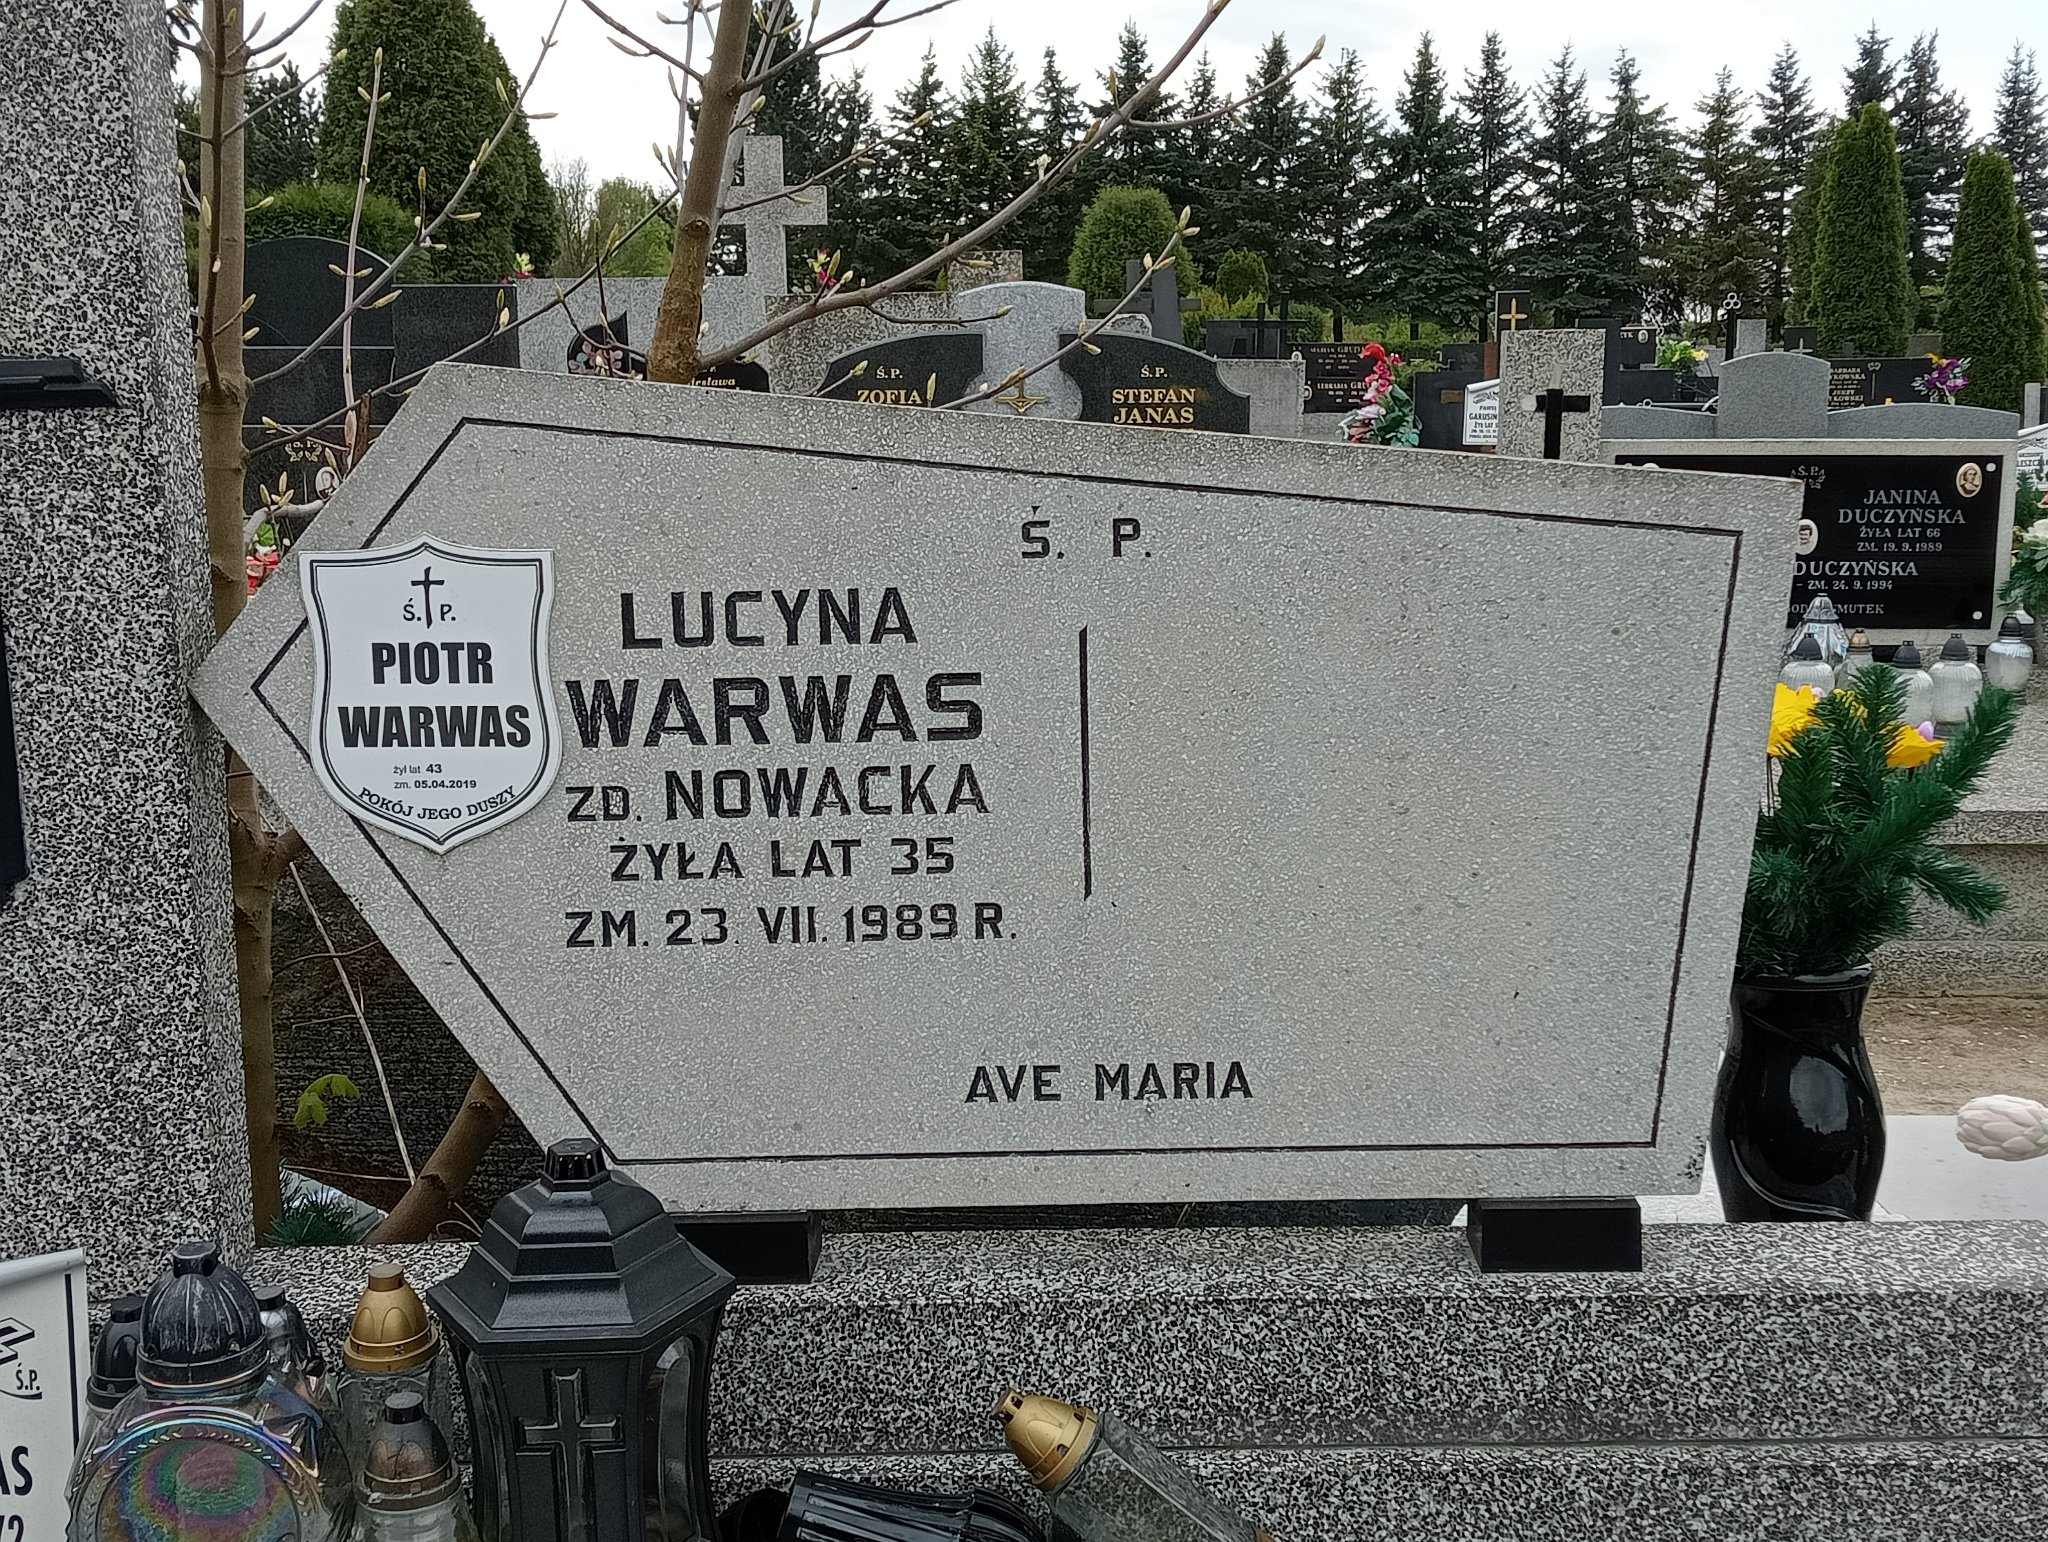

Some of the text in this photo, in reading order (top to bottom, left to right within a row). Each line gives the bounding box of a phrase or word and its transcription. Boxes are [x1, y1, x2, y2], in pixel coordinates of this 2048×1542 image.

[1337, 345, 1364, 353] GRUD
[876, 365, 904, 380] Ś.P.
[1141, 364, 1168, 379] Ś.P.
[857, 388, 923, 406] ZOFIA
[1112, 387, 1196, 405] STEFAN
[1113, 407, 1195, 425] JANAS
[1863, 489, 1942, 505] JANINA
[1838, 507, 1966, 525] DUCZYŃSKA
[1859, 525, 1942, 538] ŻYŁA LAT 66
[1857, 541, 1879, 552] ZM.
[1915, 541, 1943, 552] 1989
[1792, 558, 1919, 577] DUCZYŃSKA
[1807, 580, 1829, 590] ZM.
[1867, 580, 1893, 590] 1994
[620, 586, 919, 650] LUCYNA
[371, 641, 494, 685] PIOTR
[565, 671, 984, 749] WARWAS
[337, 704, 531, 748] WARWAS
[409, 764, 421, 774] lat
[425, 764, 442, 774] 43
[394, 779, 477, 789] zm. 05.04.2019
[565, 763, 990, 823] ZD. NOWACKA
[358, 785, 517, 820] POKÓJ JEGO DUSZY
[611, 835, 955, 882] ŻYŁA LAT 35
[565, 908, 649, 949] ZM.
[757, 905, 829, 944] VII.
[844, 902, 959, 942] 1989
[974, 900, 1018, 940] R.
[964, 1061, 1254, 1104] AVE MARIA
